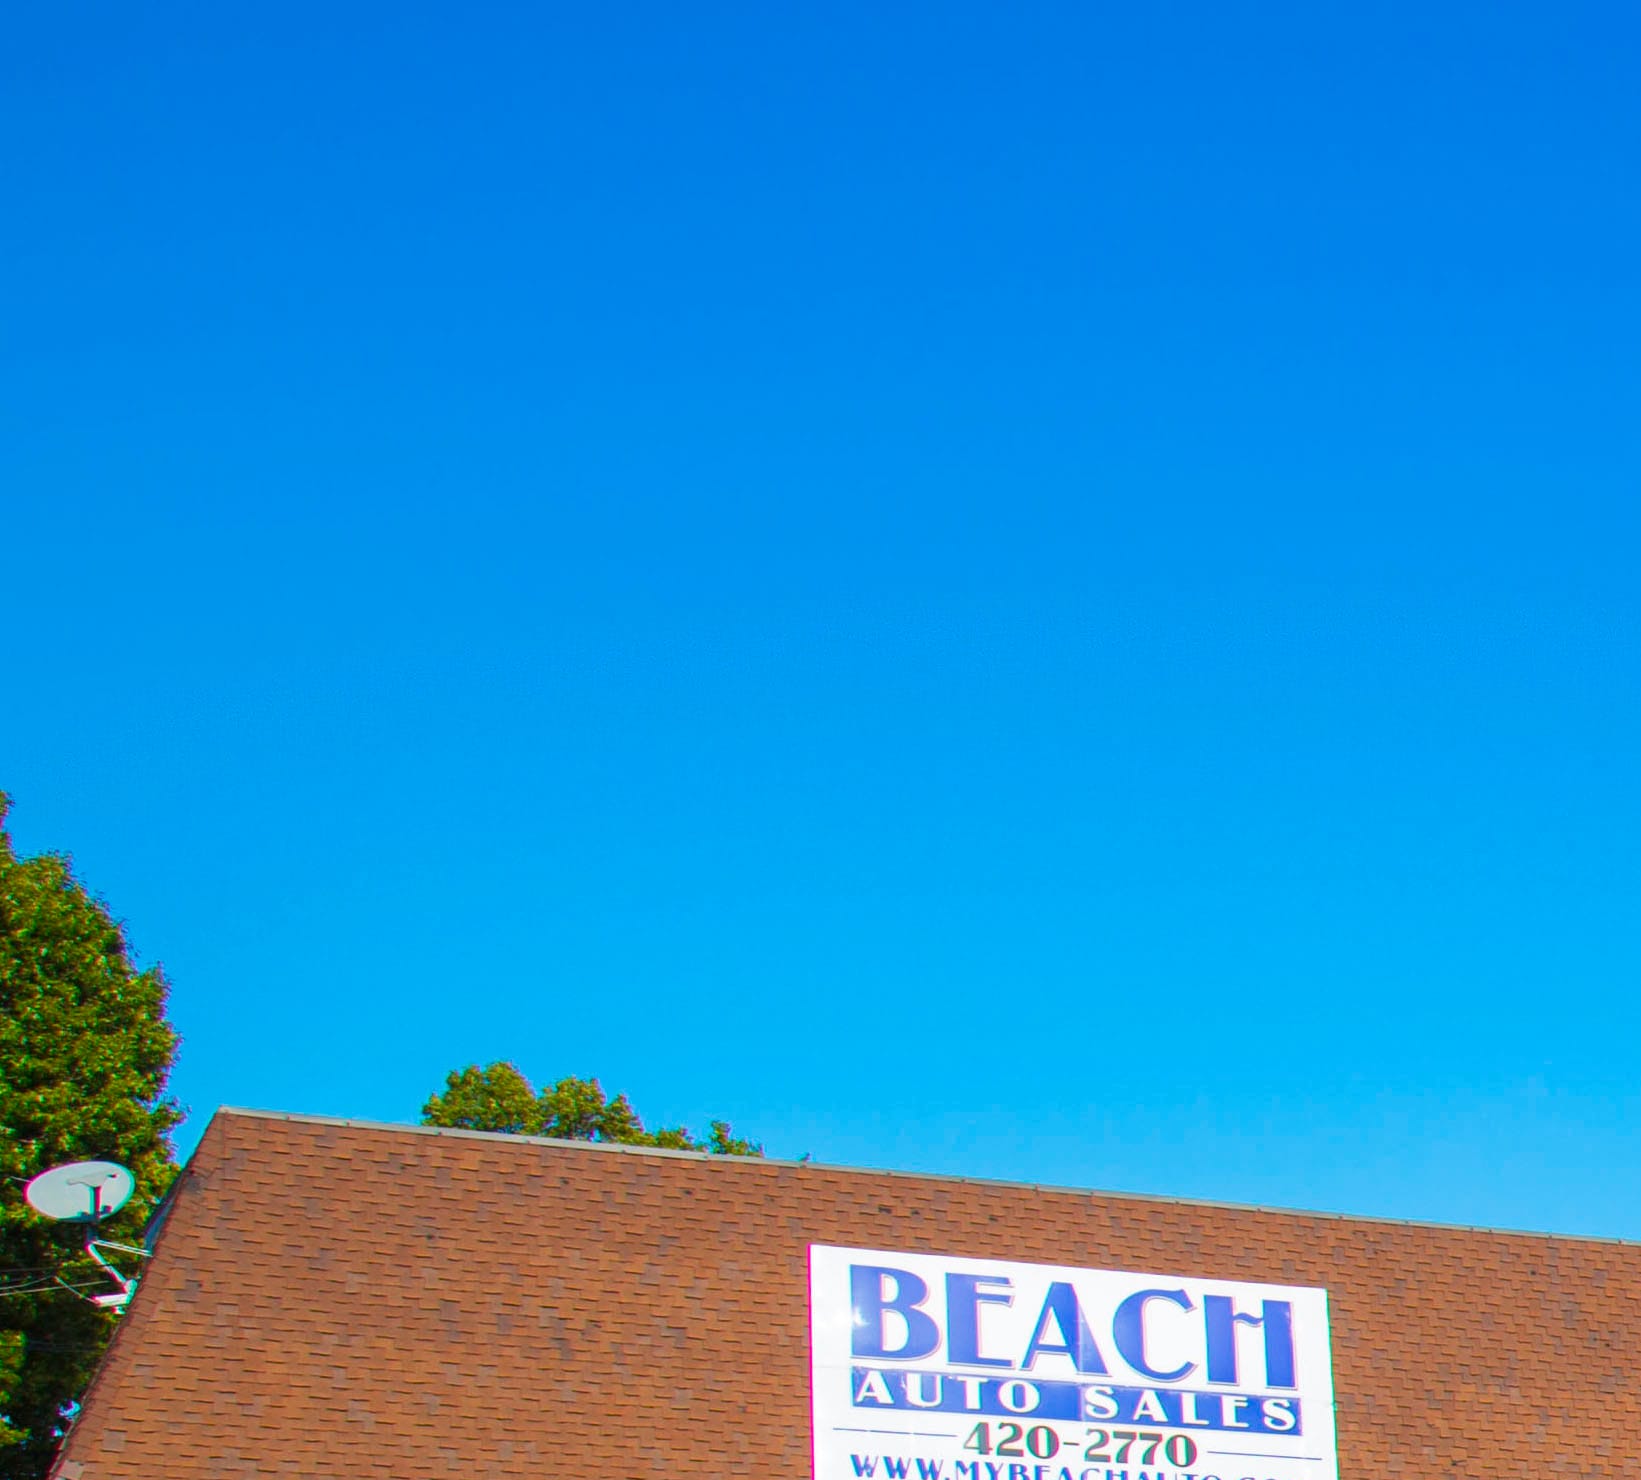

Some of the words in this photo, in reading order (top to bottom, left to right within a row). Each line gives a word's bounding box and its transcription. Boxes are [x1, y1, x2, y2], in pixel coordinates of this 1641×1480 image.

[850, 1264, 1298, 1390] BEACH
[856, 1370, 1042, 1413] AUTO
[1084, 1385, 1297, 1431] SALES
[963, 1422, 1198, 1468] 420-2770
